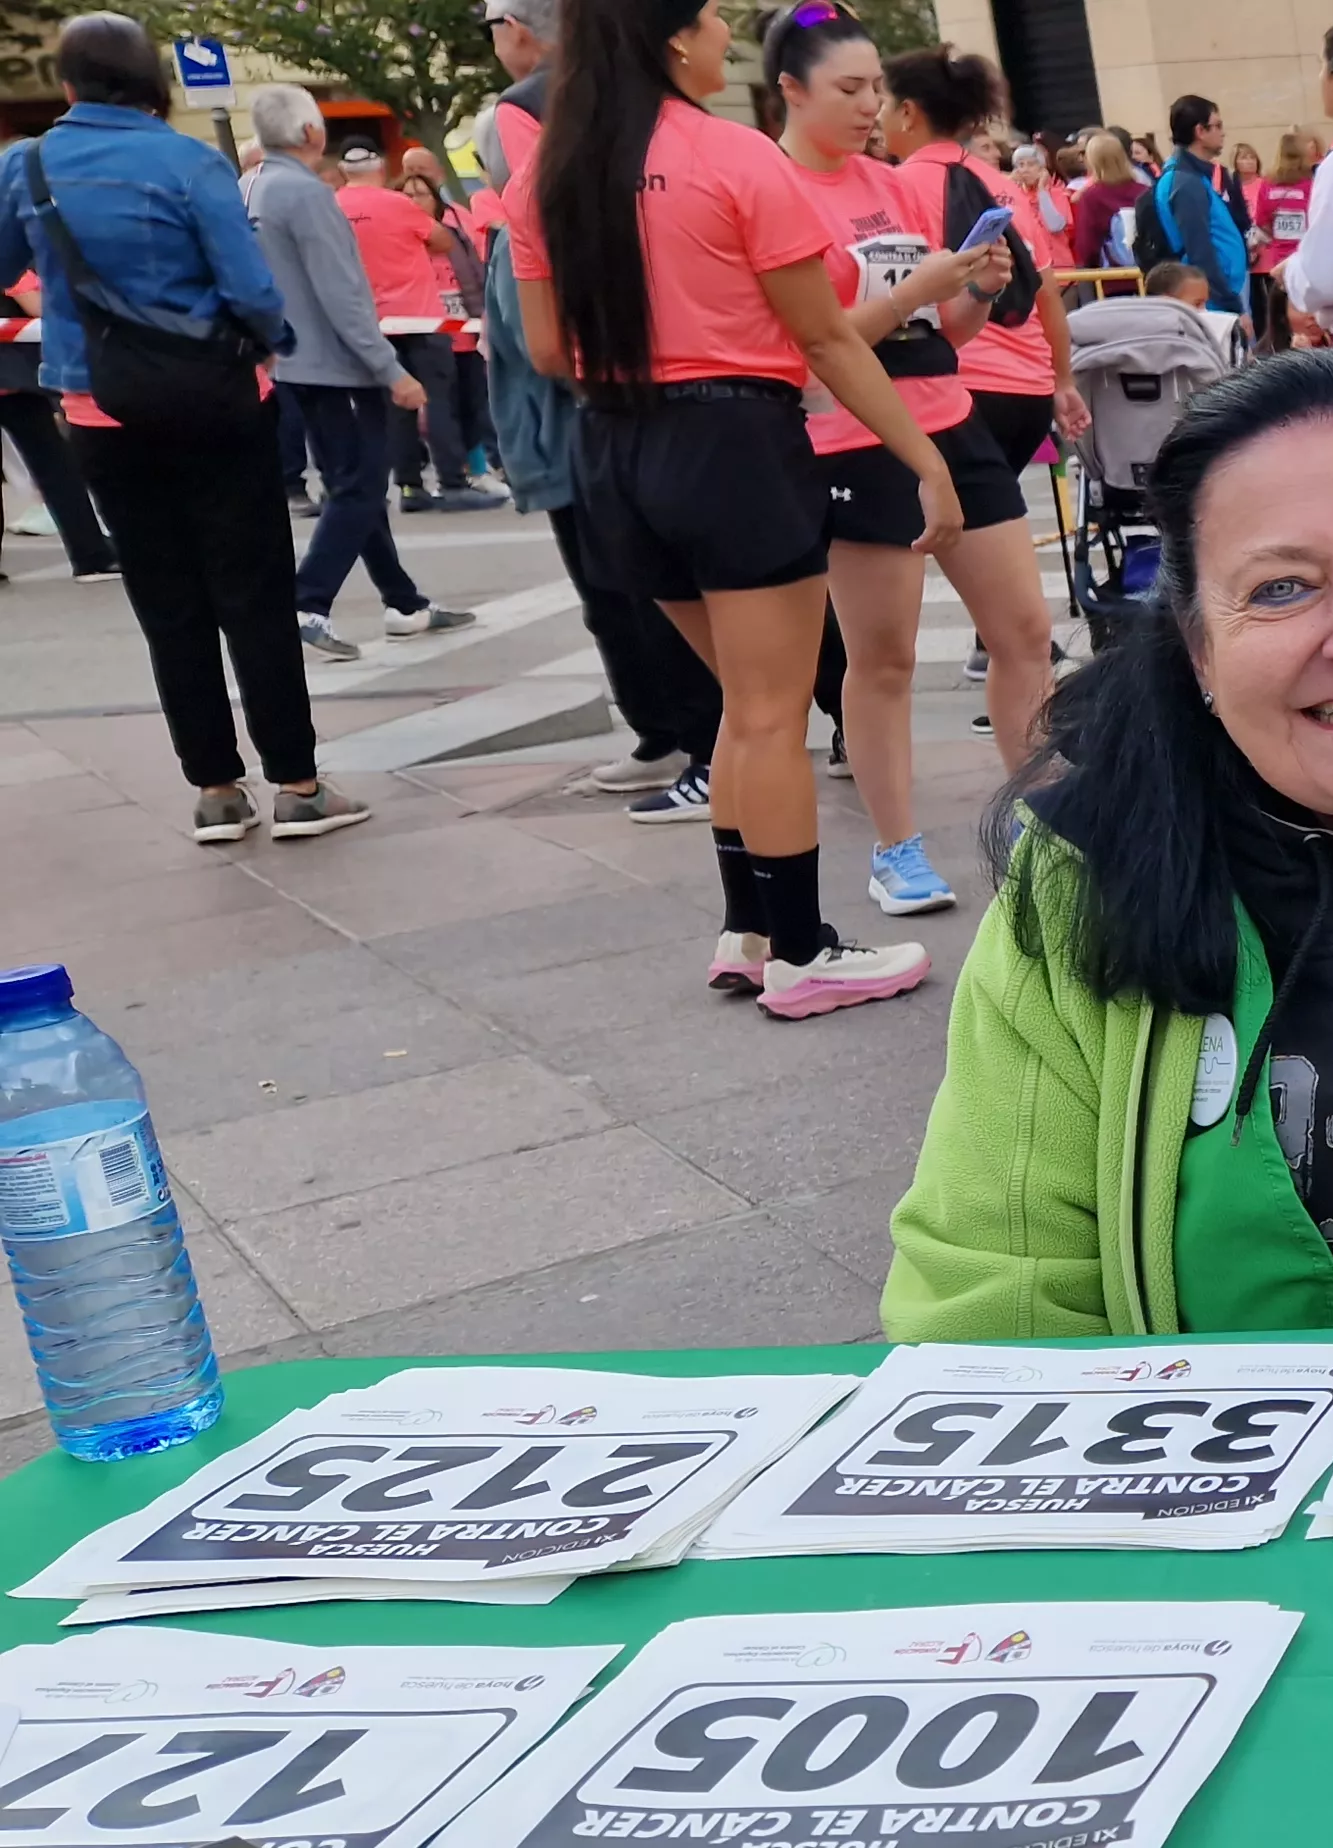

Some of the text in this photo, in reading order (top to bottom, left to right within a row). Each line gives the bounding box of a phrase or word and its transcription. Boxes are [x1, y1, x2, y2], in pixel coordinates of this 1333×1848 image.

[864, 1399, 1317, 1466] 3315
[221, 1441, 714, 1514] 2125
[834, 1473, 1251, 1501] CONTRA EL CÁNCER
[963, 1497, 1090, 1512] HUESCA
[1155, 1492, 1266, 1519] XI EDICIÓN
[180, 1516, 610, 1547] CONTRA EL CÁNCER
[307, 1541, 441, 1558] HUESCA
[500, 1531, 618, 1566] XI EDICIÓN
[1163, 1641, 1201, 1654] hoya
[613, 1690, 1145, 1794] 1005
[570, 1798, 1102, 1844] CONTRA EL CÁNCER
[1092, 1826, 1120, 1843] XI
